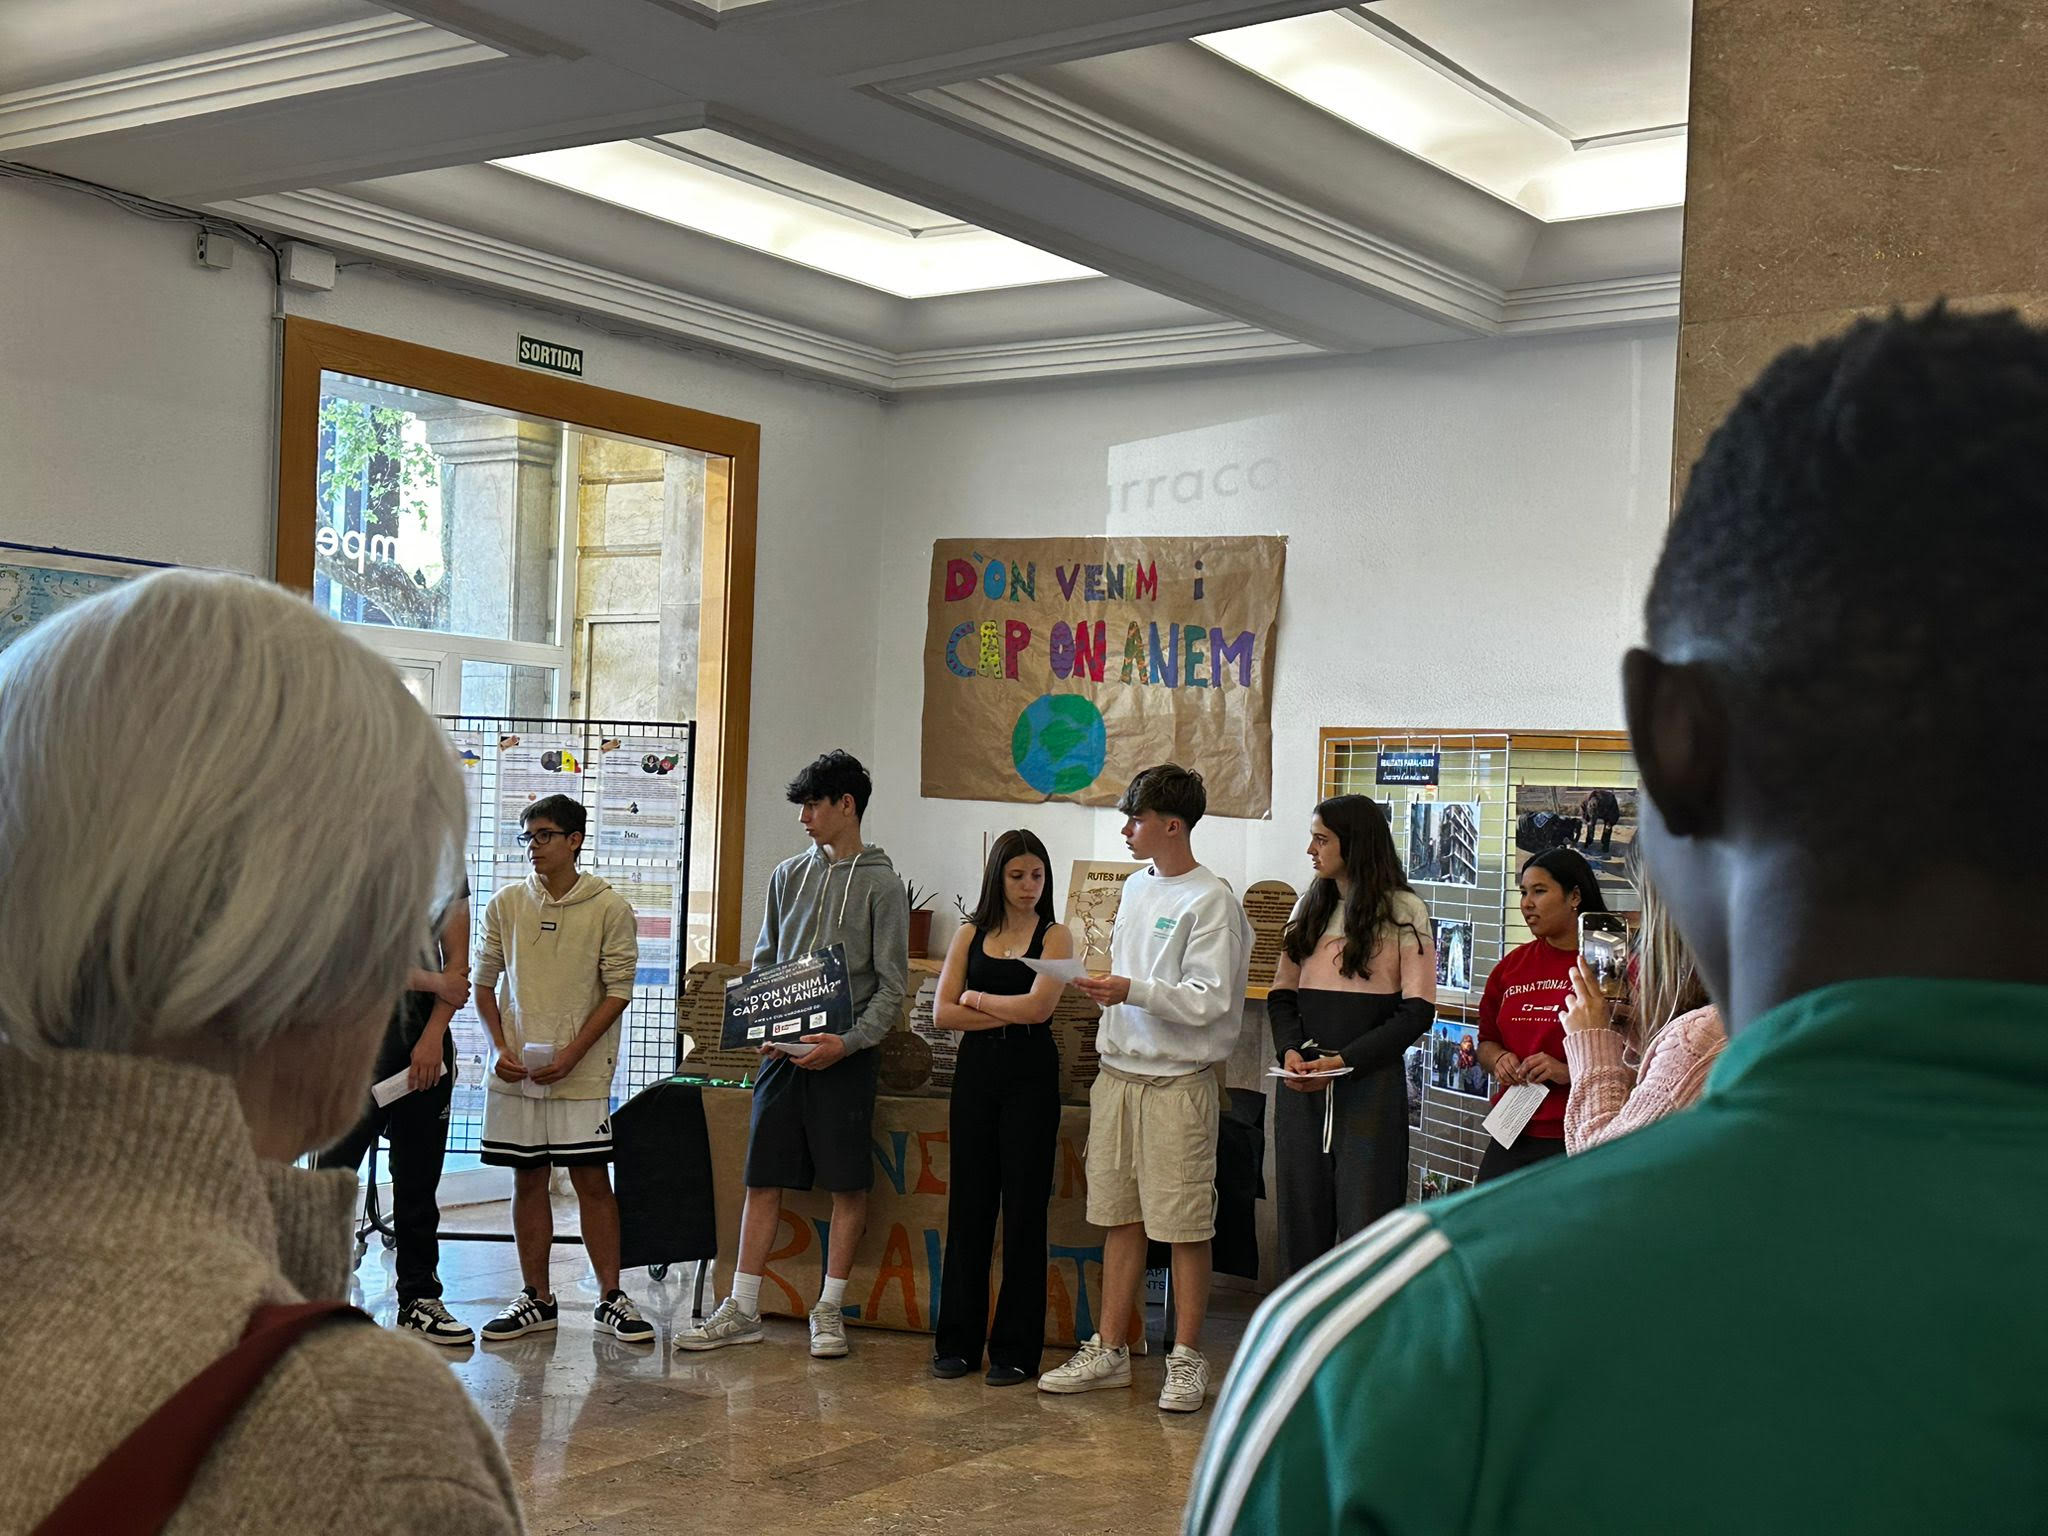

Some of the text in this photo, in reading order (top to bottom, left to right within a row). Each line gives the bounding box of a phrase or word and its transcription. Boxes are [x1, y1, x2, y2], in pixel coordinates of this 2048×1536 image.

[521, 341, 580, 371] SORTIDA
[1055, 558, 1159, 602] VENIM
[945, 619, 1256, 688] CAP ON ANEM
[1087, 872, 1114, 881] RUTES
[783, 977, 821, 994] VENIM
[732, 1003, 758, 1017] CAP
[762, 1001, 770, 1011] A
[773, 997, 792, 1008] ON
